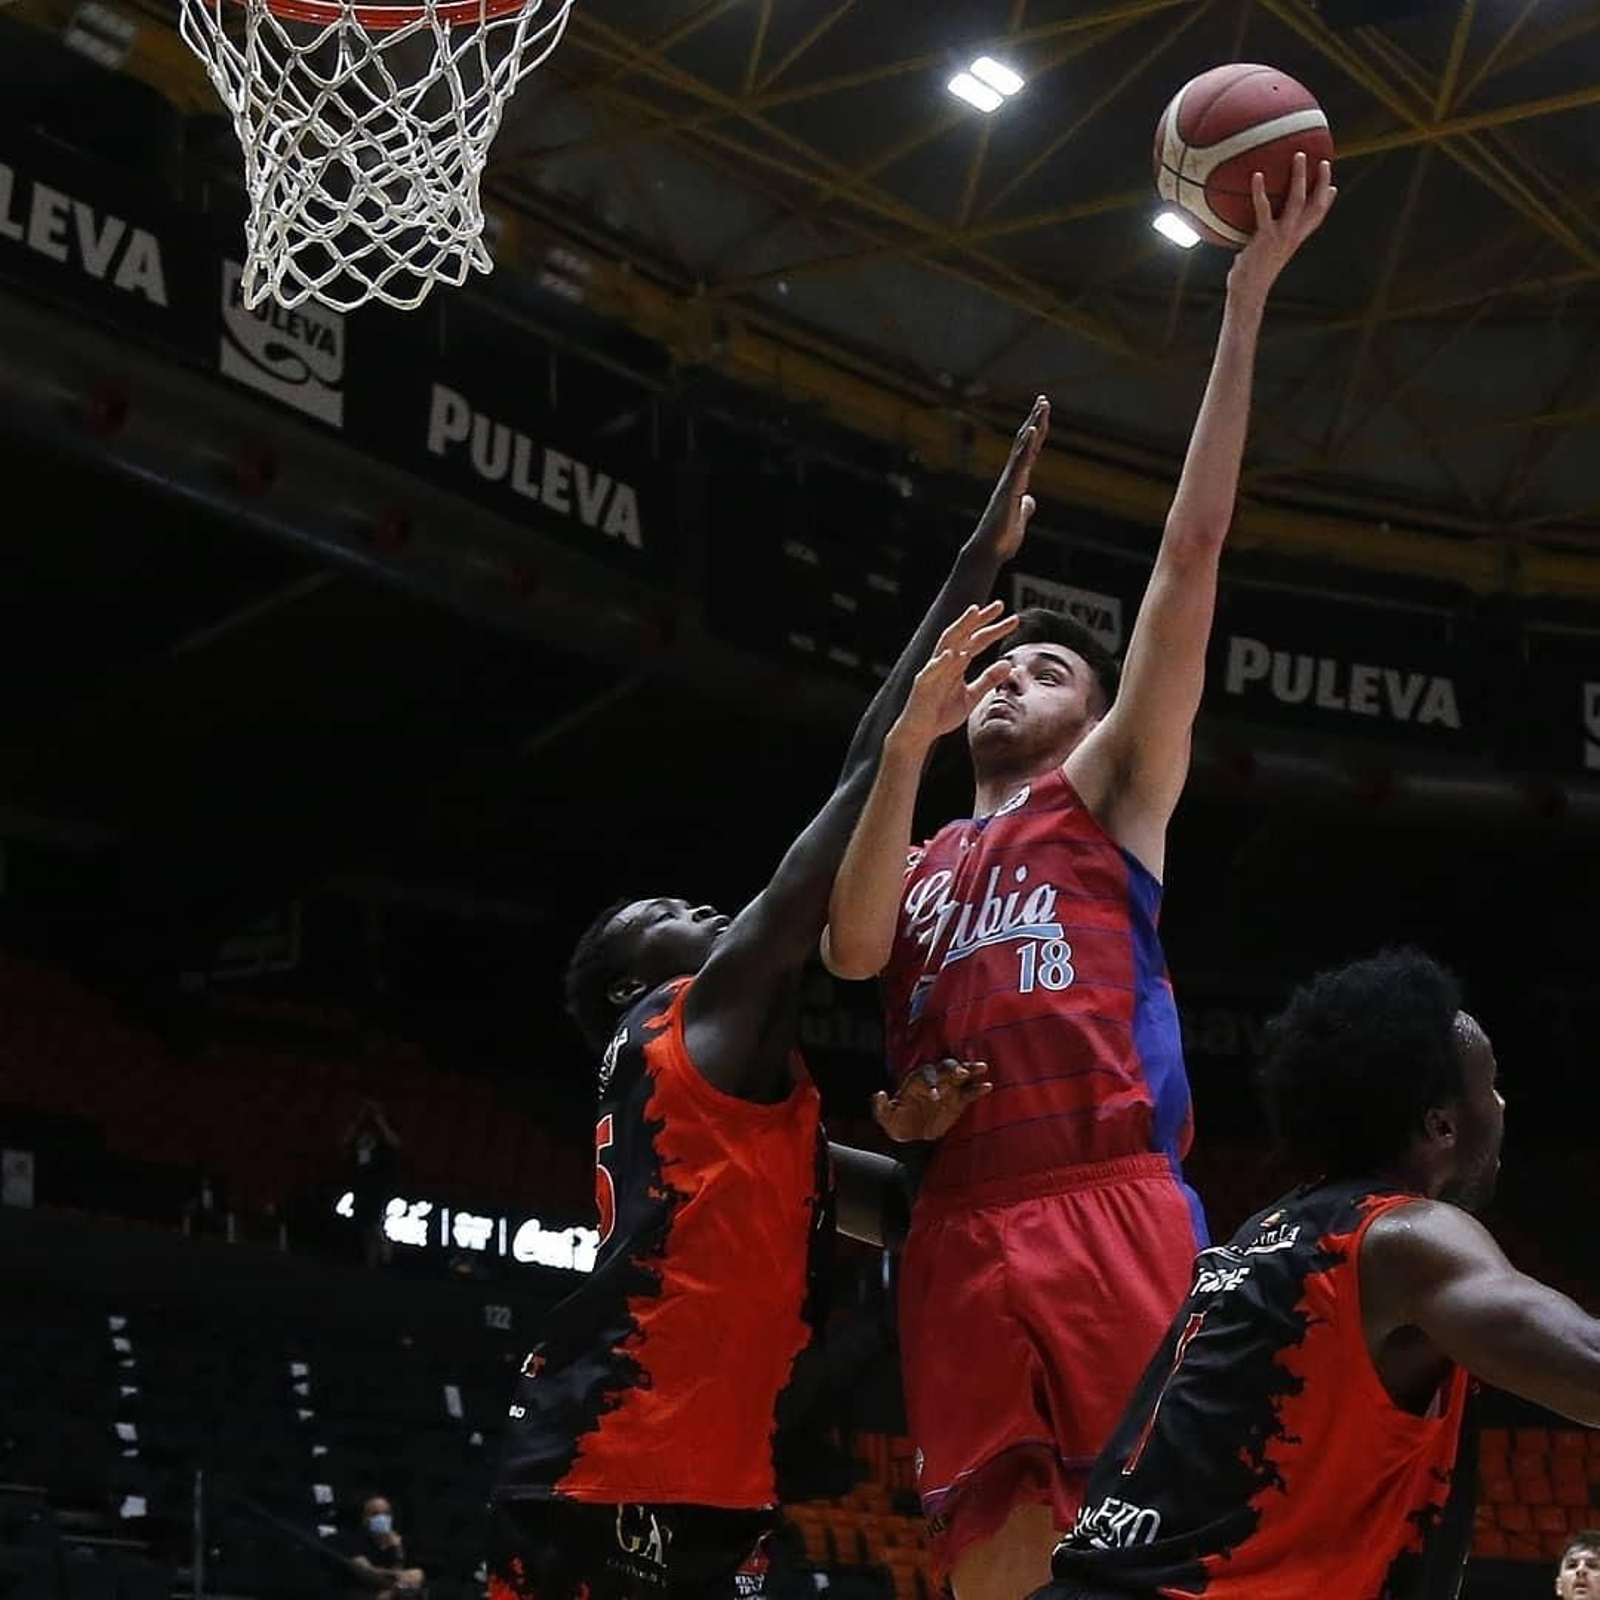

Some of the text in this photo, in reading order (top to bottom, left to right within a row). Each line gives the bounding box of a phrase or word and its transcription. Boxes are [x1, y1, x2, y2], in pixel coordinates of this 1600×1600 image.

[427, 382, 643, 549] PULEVA
[1226, 635, 1461, 729] PULEVA
[1016, 939, 1075, 994] 18
